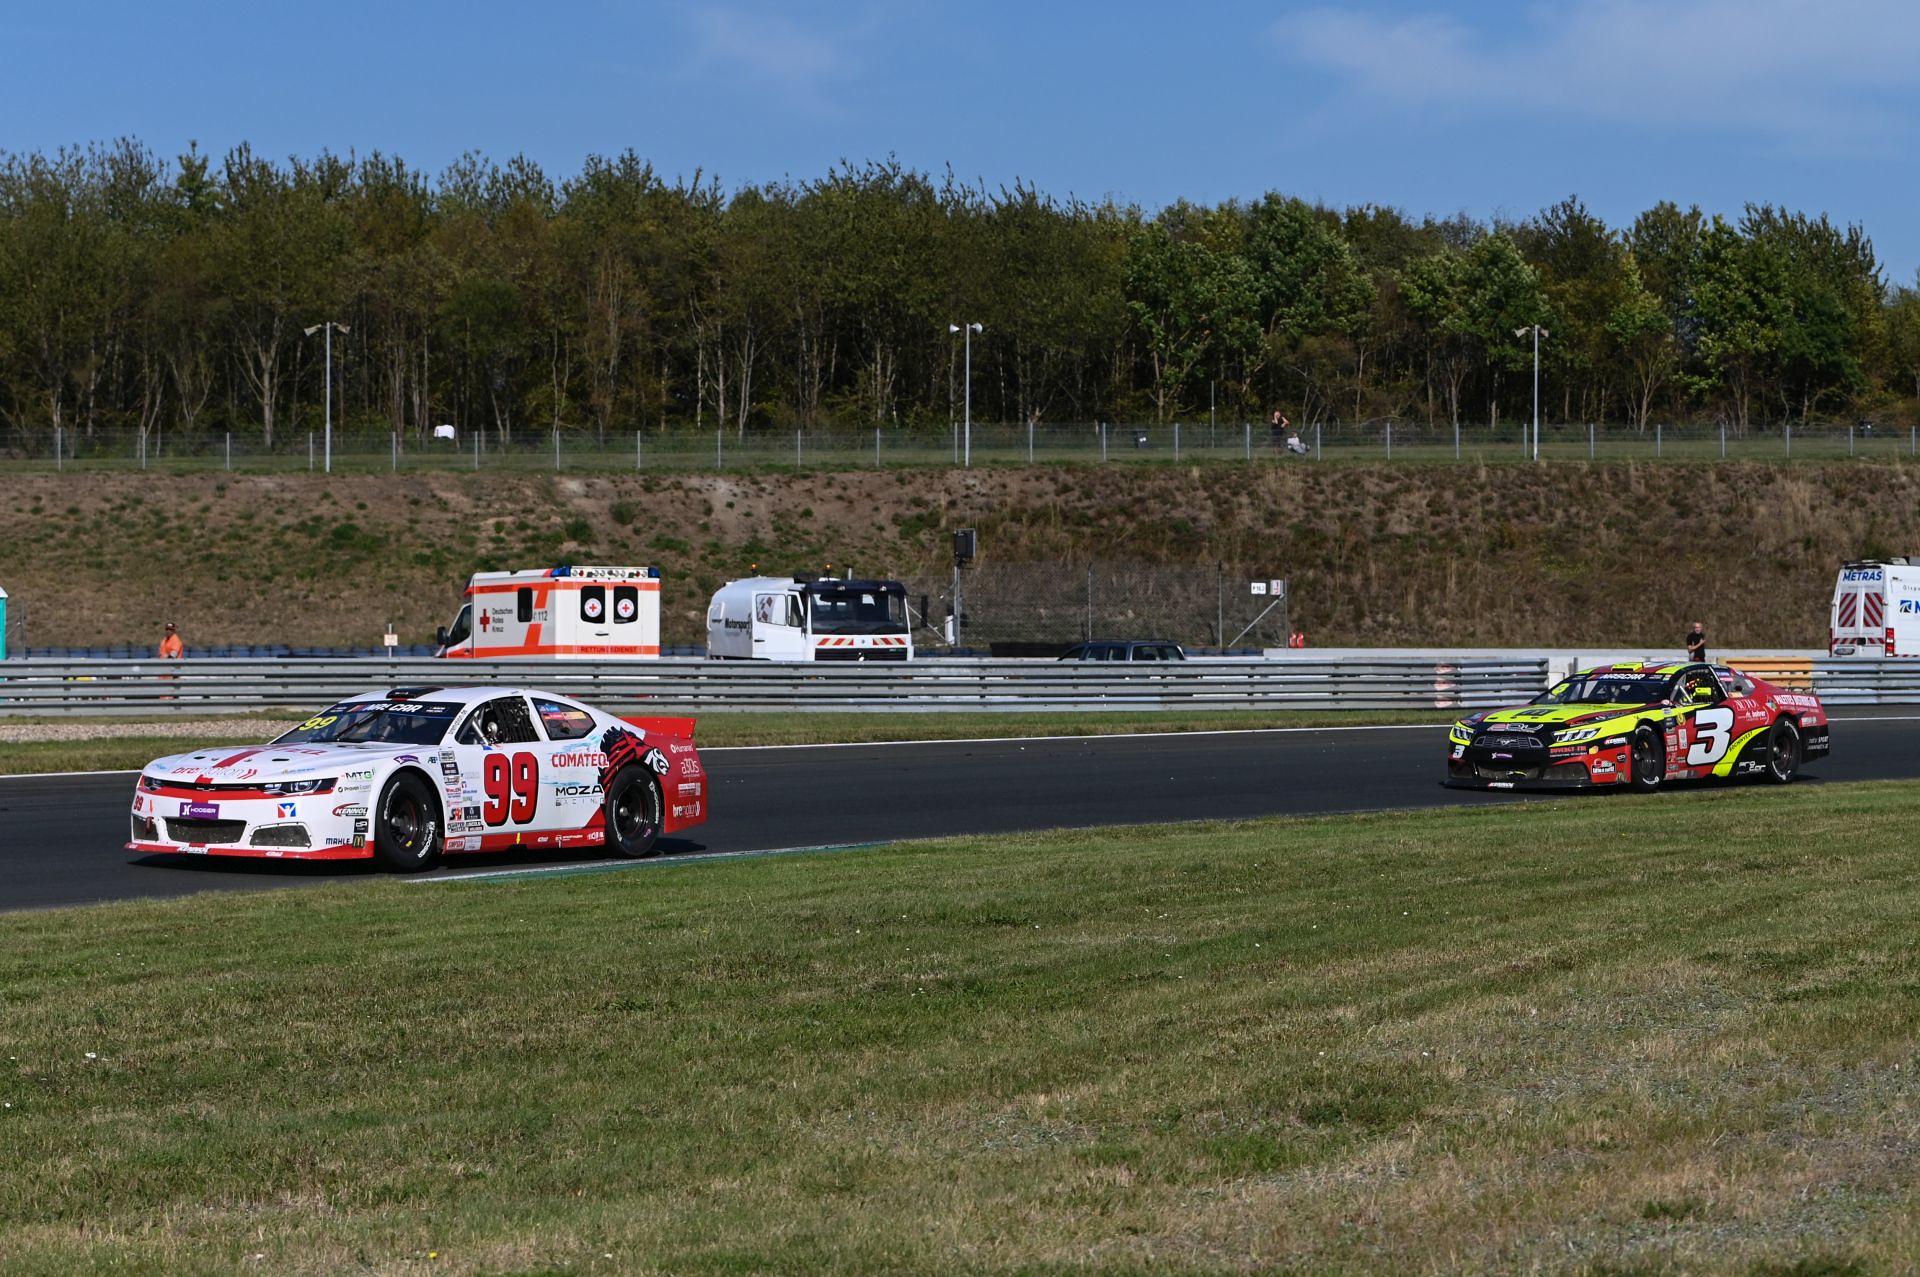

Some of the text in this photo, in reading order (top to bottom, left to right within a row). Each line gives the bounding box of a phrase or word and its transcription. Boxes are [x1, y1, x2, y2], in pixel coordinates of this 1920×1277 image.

[1843, 571, 1882, 582] METRAS
[538, 611, 548, 622] 112
[299, 715, 337, 731] 99
[1687, 707, 1735, 766] 3
[1452, 744, 1466, 758] 3
[551, 753, 608, 768] COMATEQ
[483, 752, 540, 827] 99
[556, 786, 604, 796] MOZA
[190, 806, 216, 814] HOOSIER
[325, 837, 350, 845] MAHLE
